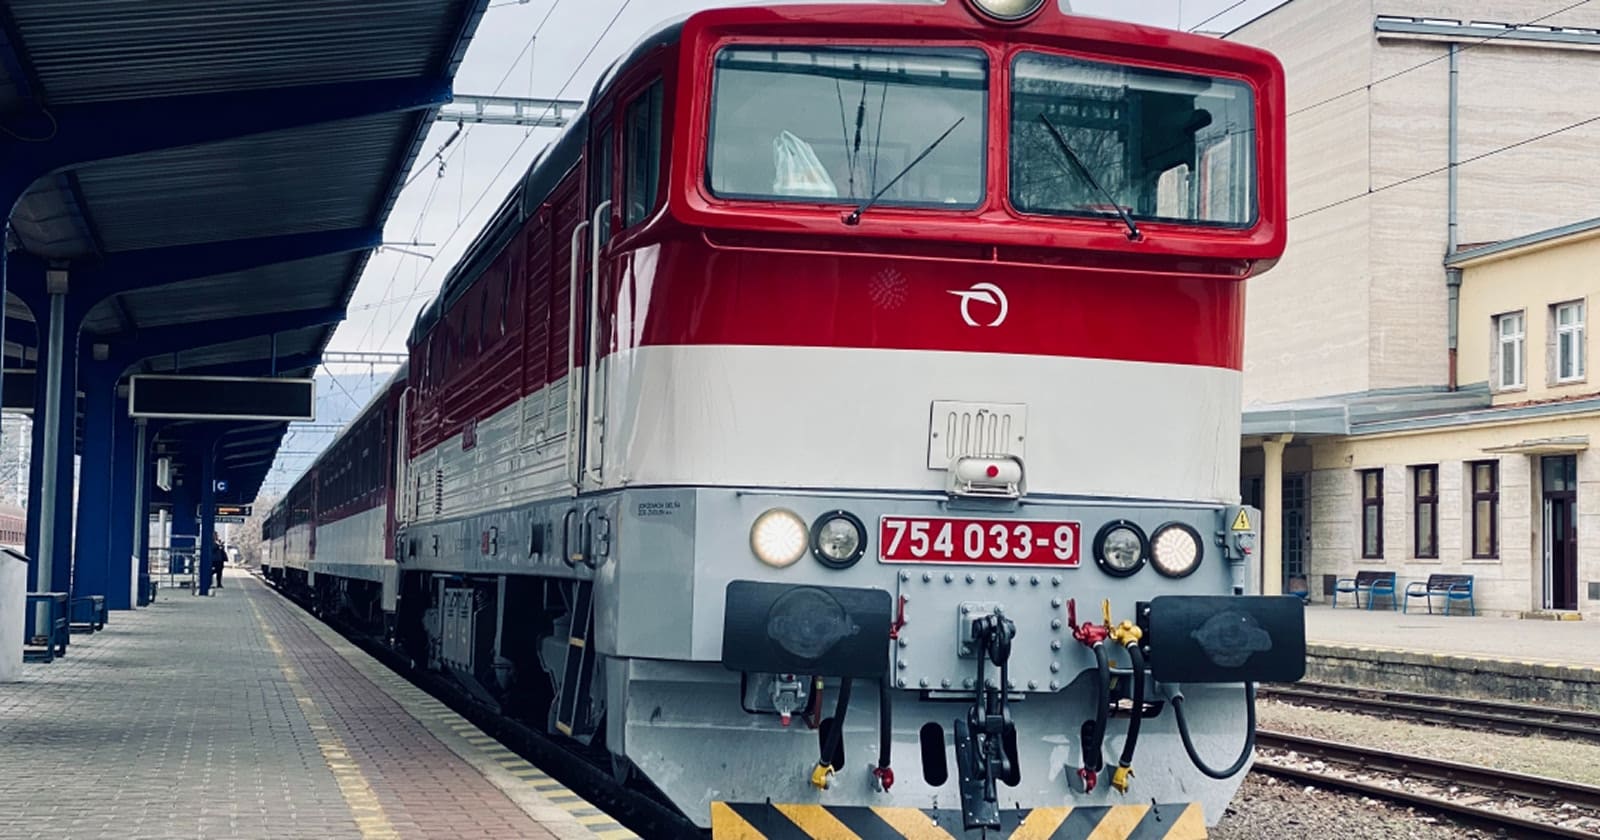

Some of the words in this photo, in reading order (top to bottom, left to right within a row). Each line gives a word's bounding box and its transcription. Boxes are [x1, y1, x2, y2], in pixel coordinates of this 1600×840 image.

[217, 481, 225, 490] C
[886, 520, 954, 558] 754
[963, 522, 1074, 560] 033-9
